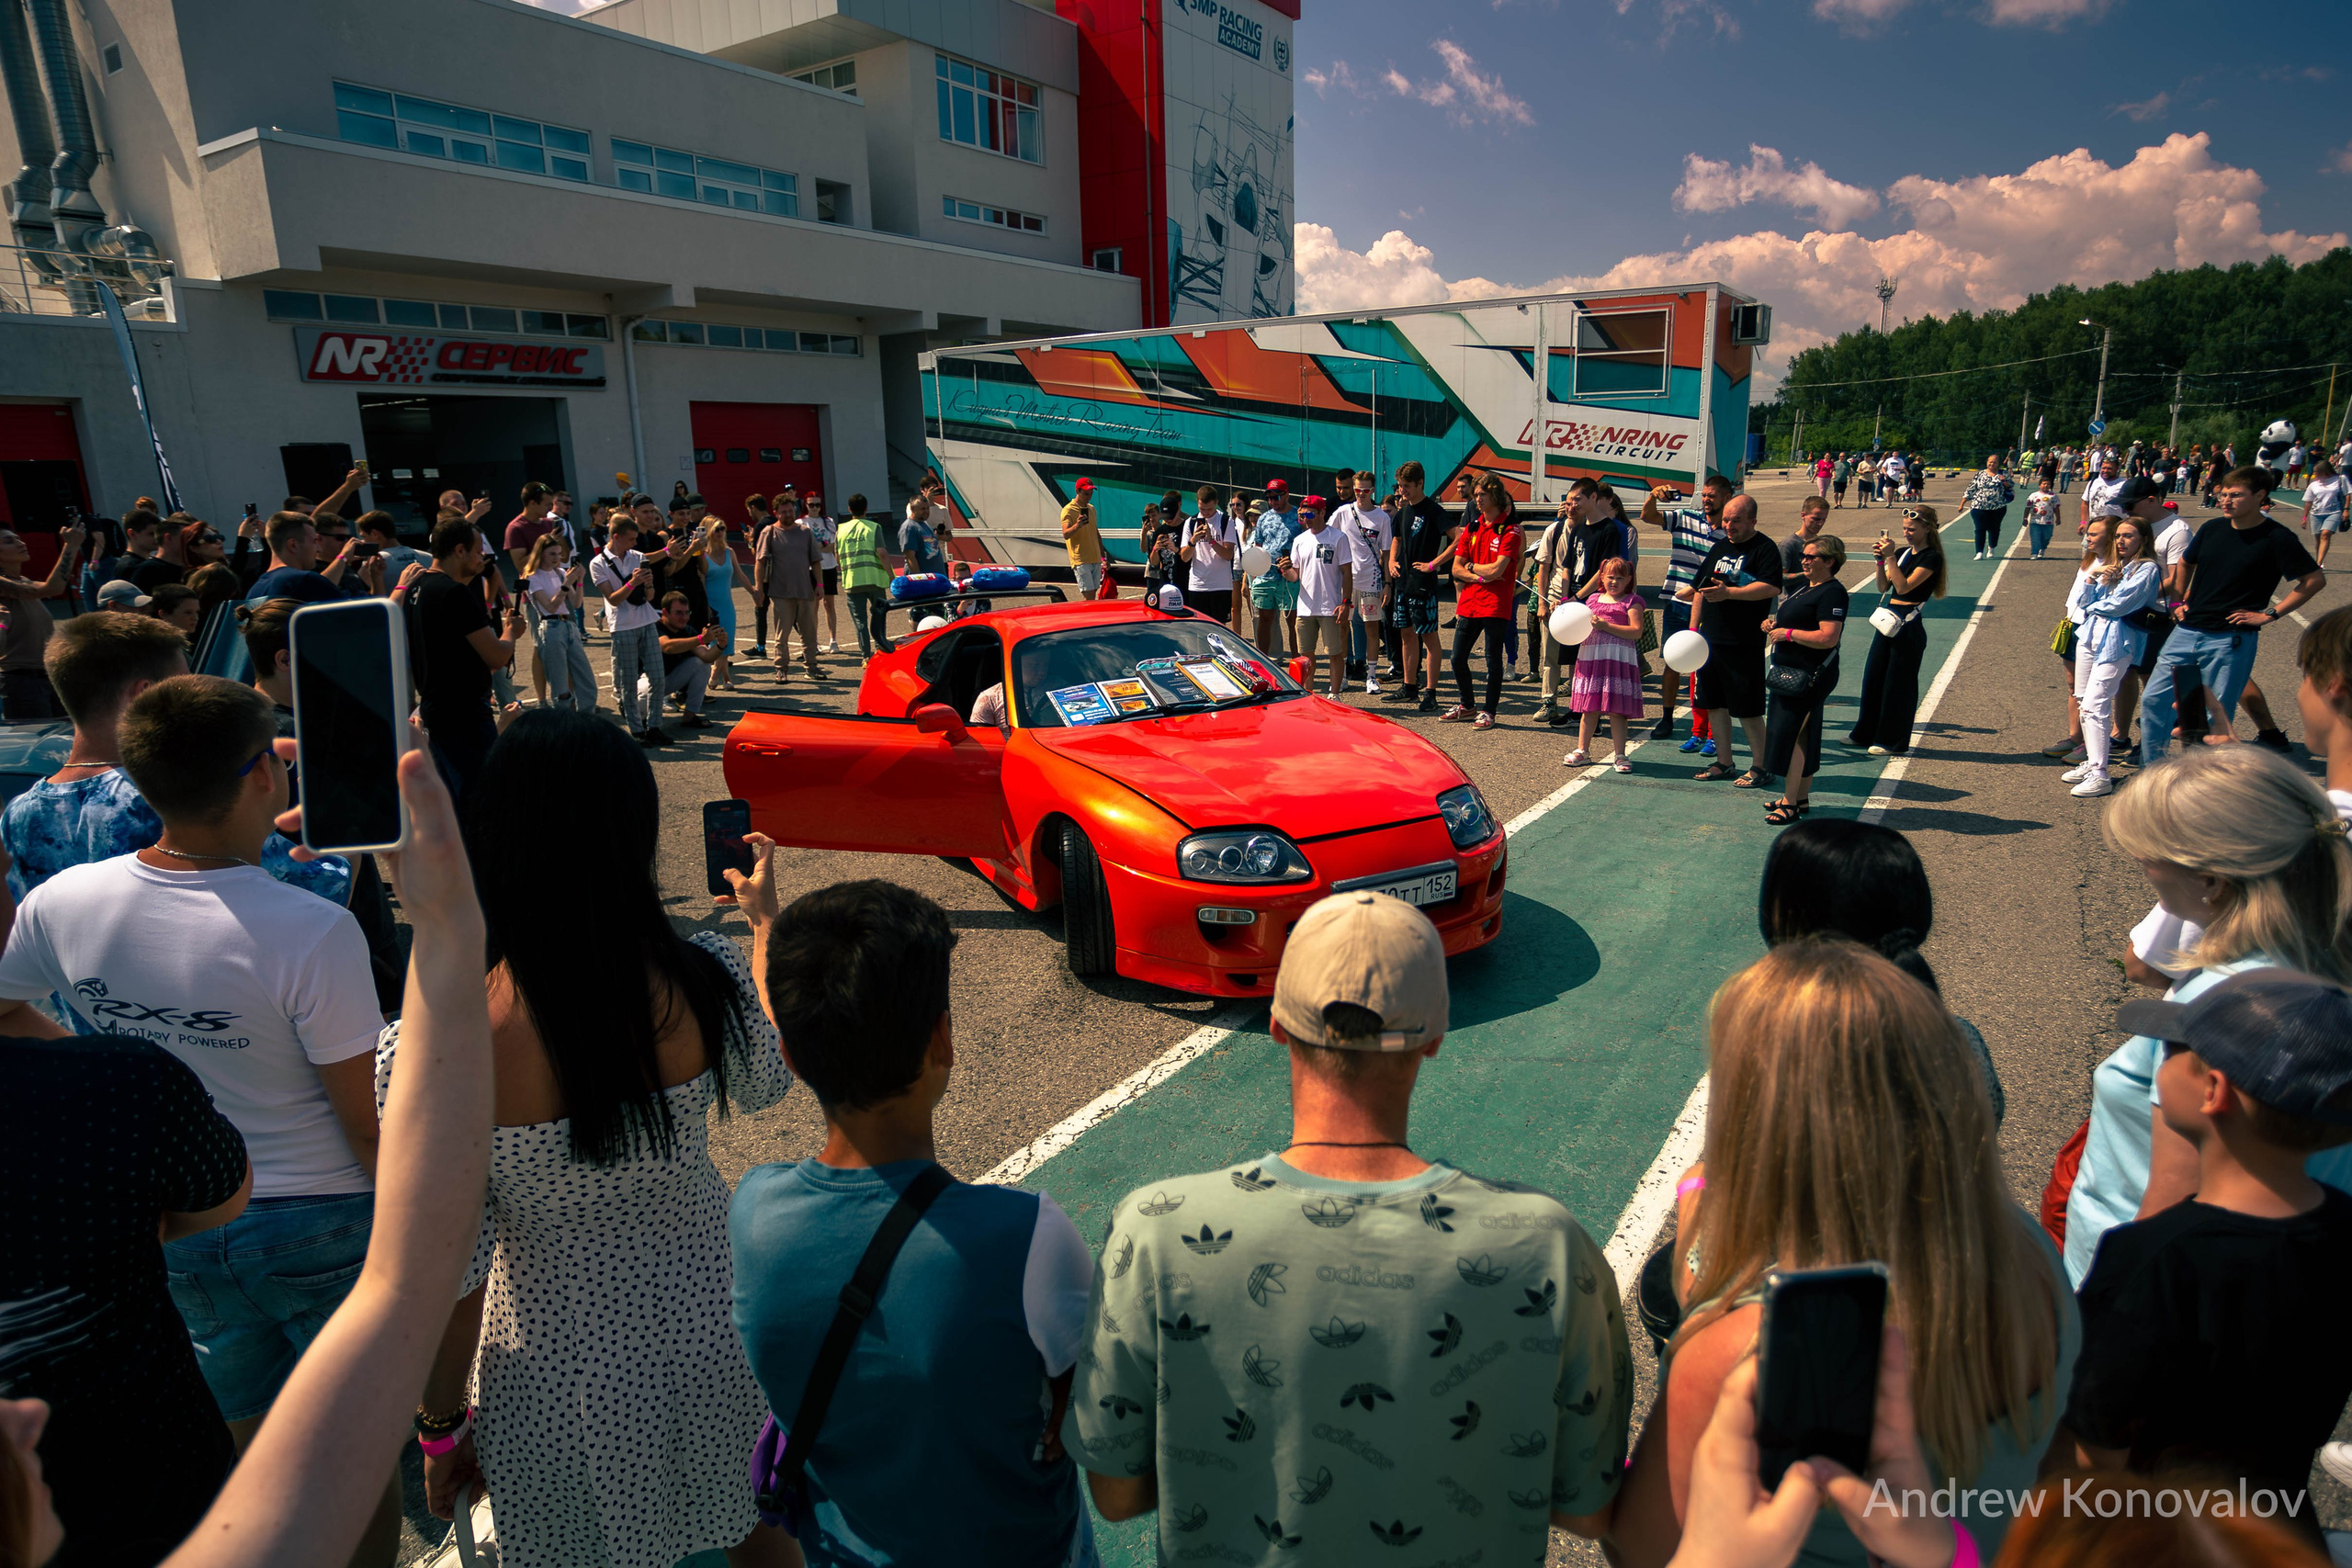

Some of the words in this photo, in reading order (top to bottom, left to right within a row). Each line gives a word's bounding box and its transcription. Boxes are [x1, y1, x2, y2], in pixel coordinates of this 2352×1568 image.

[1190, 0, 1217, 17] SMP
[1219, 6, 1262, 42] RACING
[1219, 28, 1261, 57] ACADEMY
[314, 336, 388, 376] NR
[437, 340, 588, 375] СЕРВИС
[1006, 394, 1076, 428] Mother
[1068, 402, 1142, 443] Racing
[1144, 410, 1183, 441] Team
[1593, 444, 1678, 461] CIRCUIT
[1600, 426, 1689, 450] NRING
[1426, 874, 1452, 894] 152
[1430, 892, 1443, 900] RUS
[88, 998, 243, 1032] RX-8
[119, 1027, 171, 1043] ROTARY
[179, 1033, 250, 1050] POWERED
[1316, 1264, 1415, 1291] adidas
[1430, 1339, 1510, 1397] adidas
[1311, 1423, 1395, 1471] adidas
